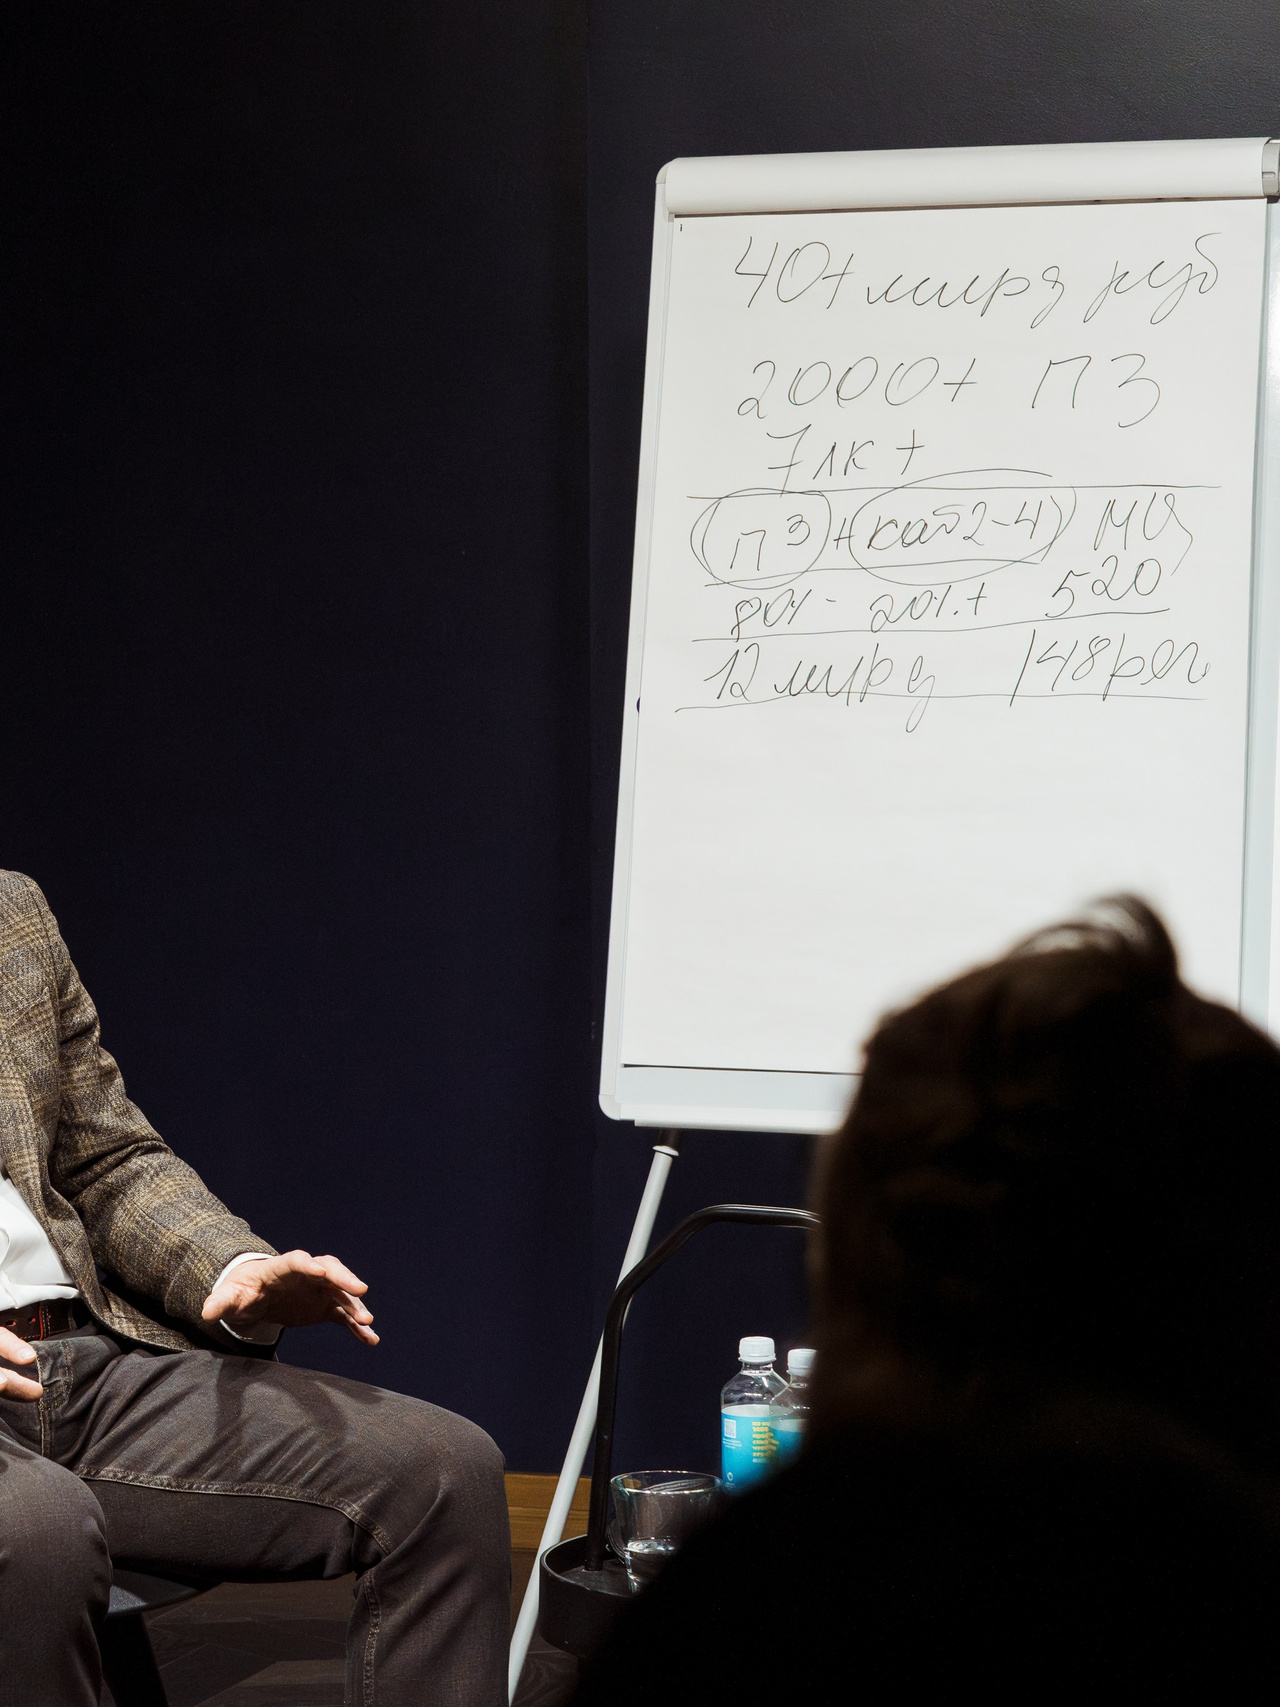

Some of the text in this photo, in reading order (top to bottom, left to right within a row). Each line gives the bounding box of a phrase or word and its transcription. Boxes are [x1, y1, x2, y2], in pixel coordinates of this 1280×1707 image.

[735, 236, 855, 309] 40+
[1083, 233, 1222, 325] руб
[737, 356, 978, 419] 2000+
[1045, 555, 1162, 617] 520
[703, 643, 760, 701] 12
